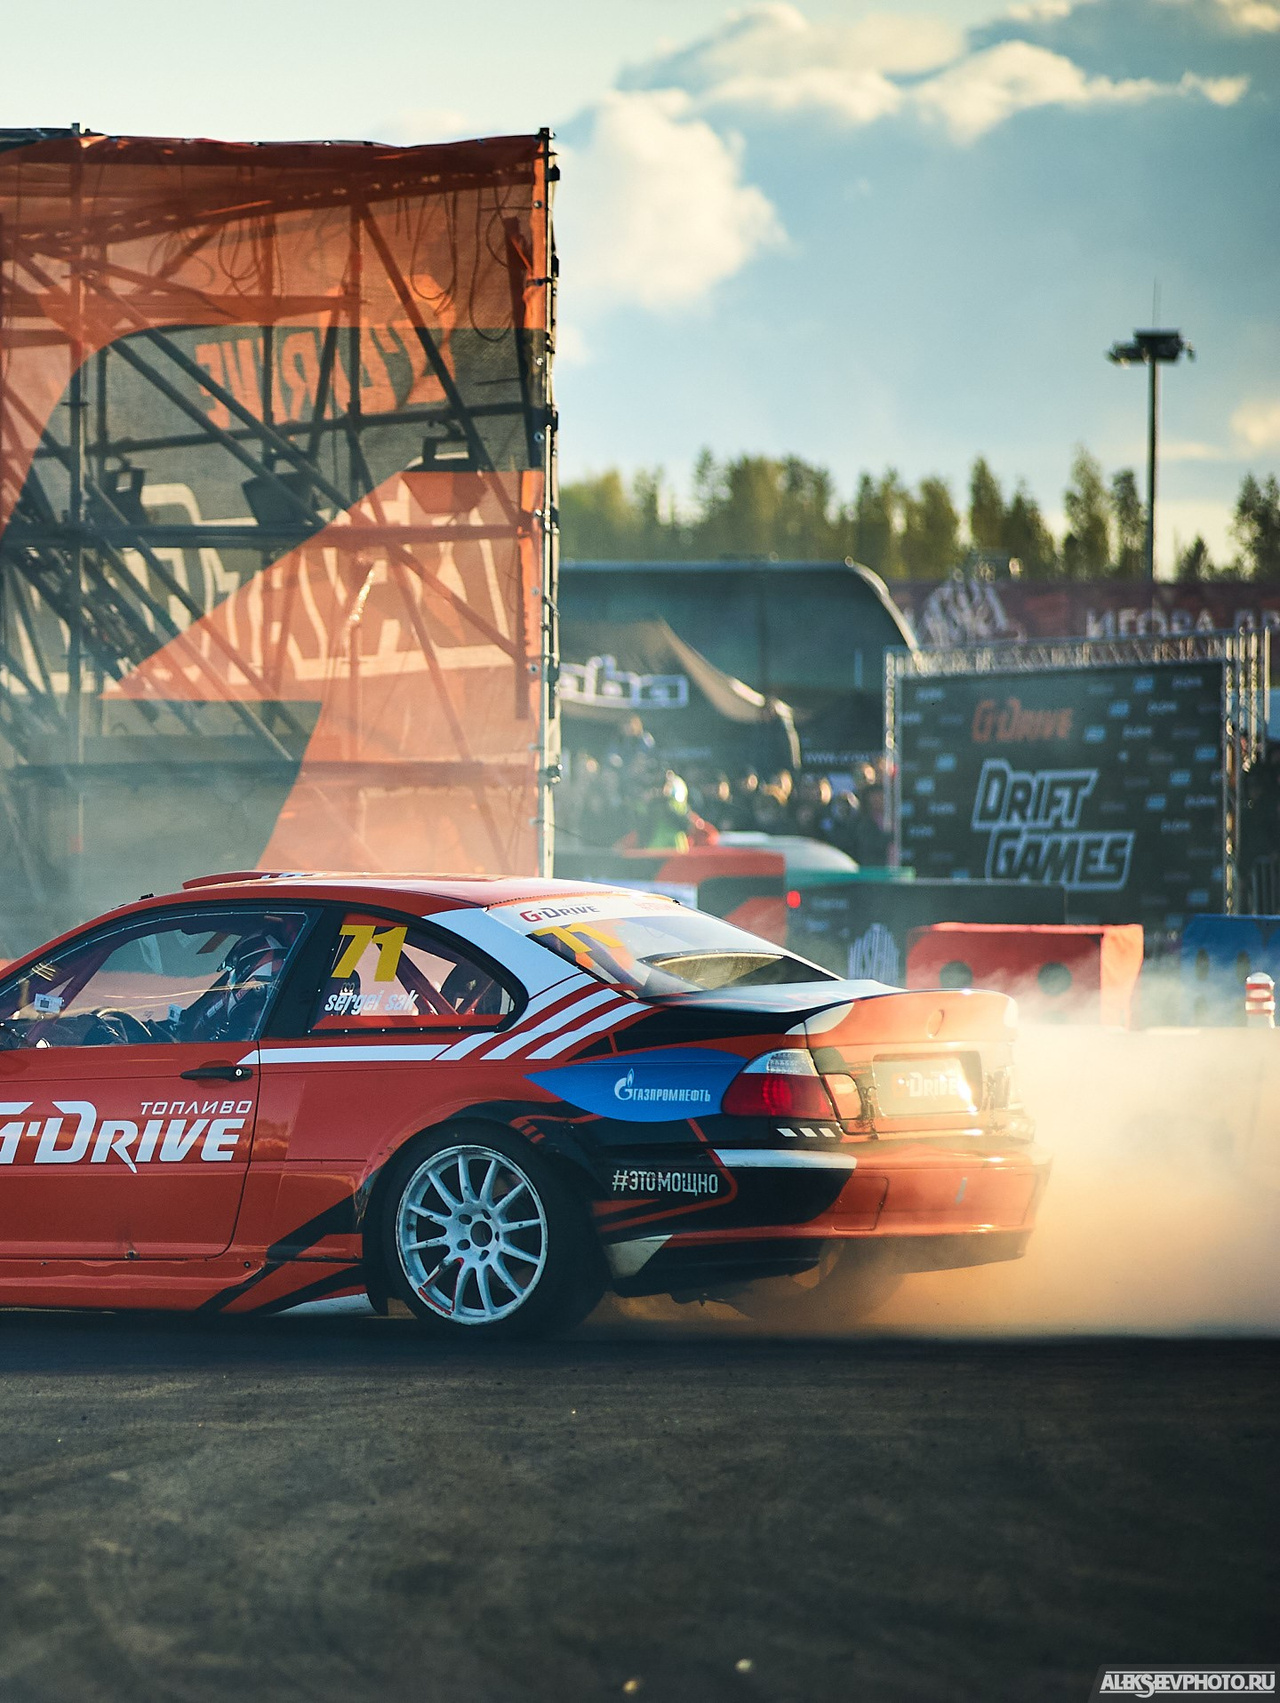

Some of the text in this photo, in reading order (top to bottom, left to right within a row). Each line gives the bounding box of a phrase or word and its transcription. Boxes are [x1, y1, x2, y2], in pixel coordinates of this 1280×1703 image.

[972, 758, 1100, 831] DRIFT
[984, 829, 1136, 891] GAMES
[331, 924, 408, 982] 71
[530, 922, 625, 954] 71
[324, 989, 420, 1015] sergei sak
[140, 1100, 253, 1116] ТОПЛИВО
[632, 1088, 711, 1103] ГАЗПРОМНЕФТЬ
